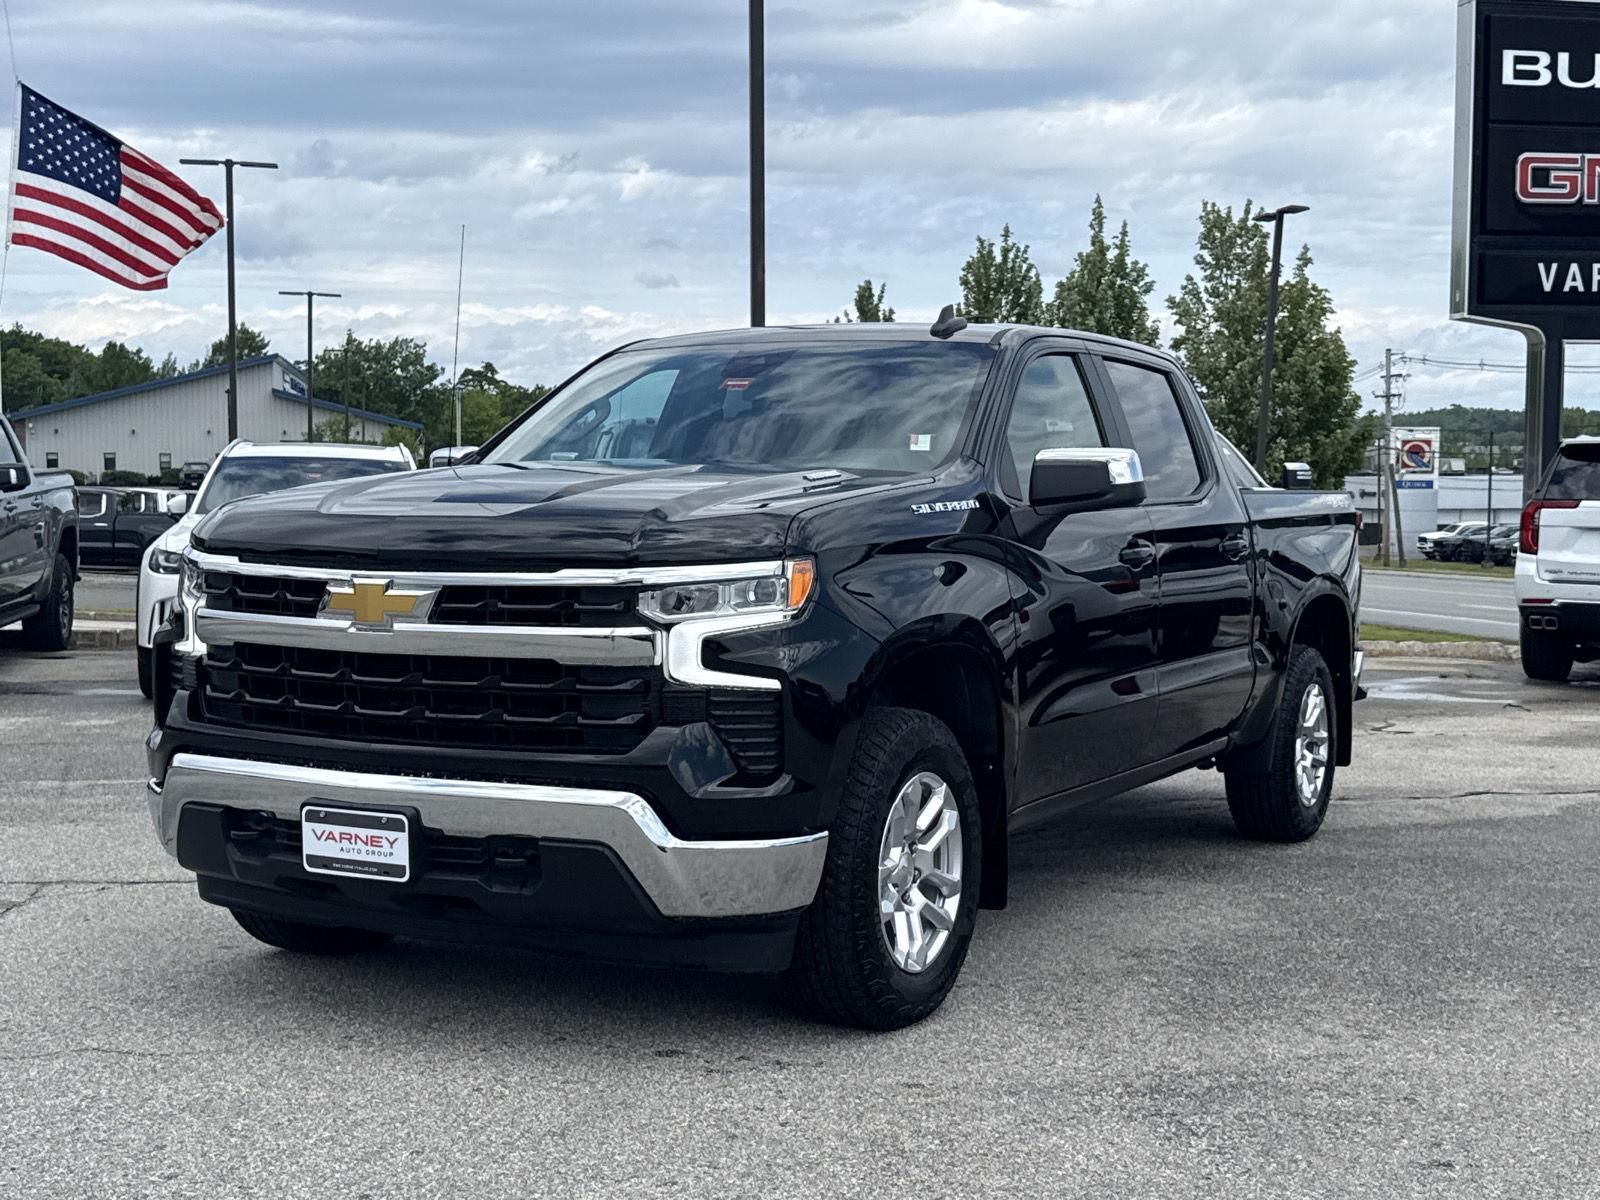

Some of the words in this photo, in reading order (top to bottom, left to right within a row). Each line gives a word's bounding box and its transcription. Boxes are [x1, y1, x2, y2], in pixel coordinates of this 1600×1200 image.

[911, 499, 980, 515] SILVERADO
[312, 828, 399, 849] VARNEY
[340, 846, 362, 854] AUTO
[365, 849, 394, 857] GROUP
